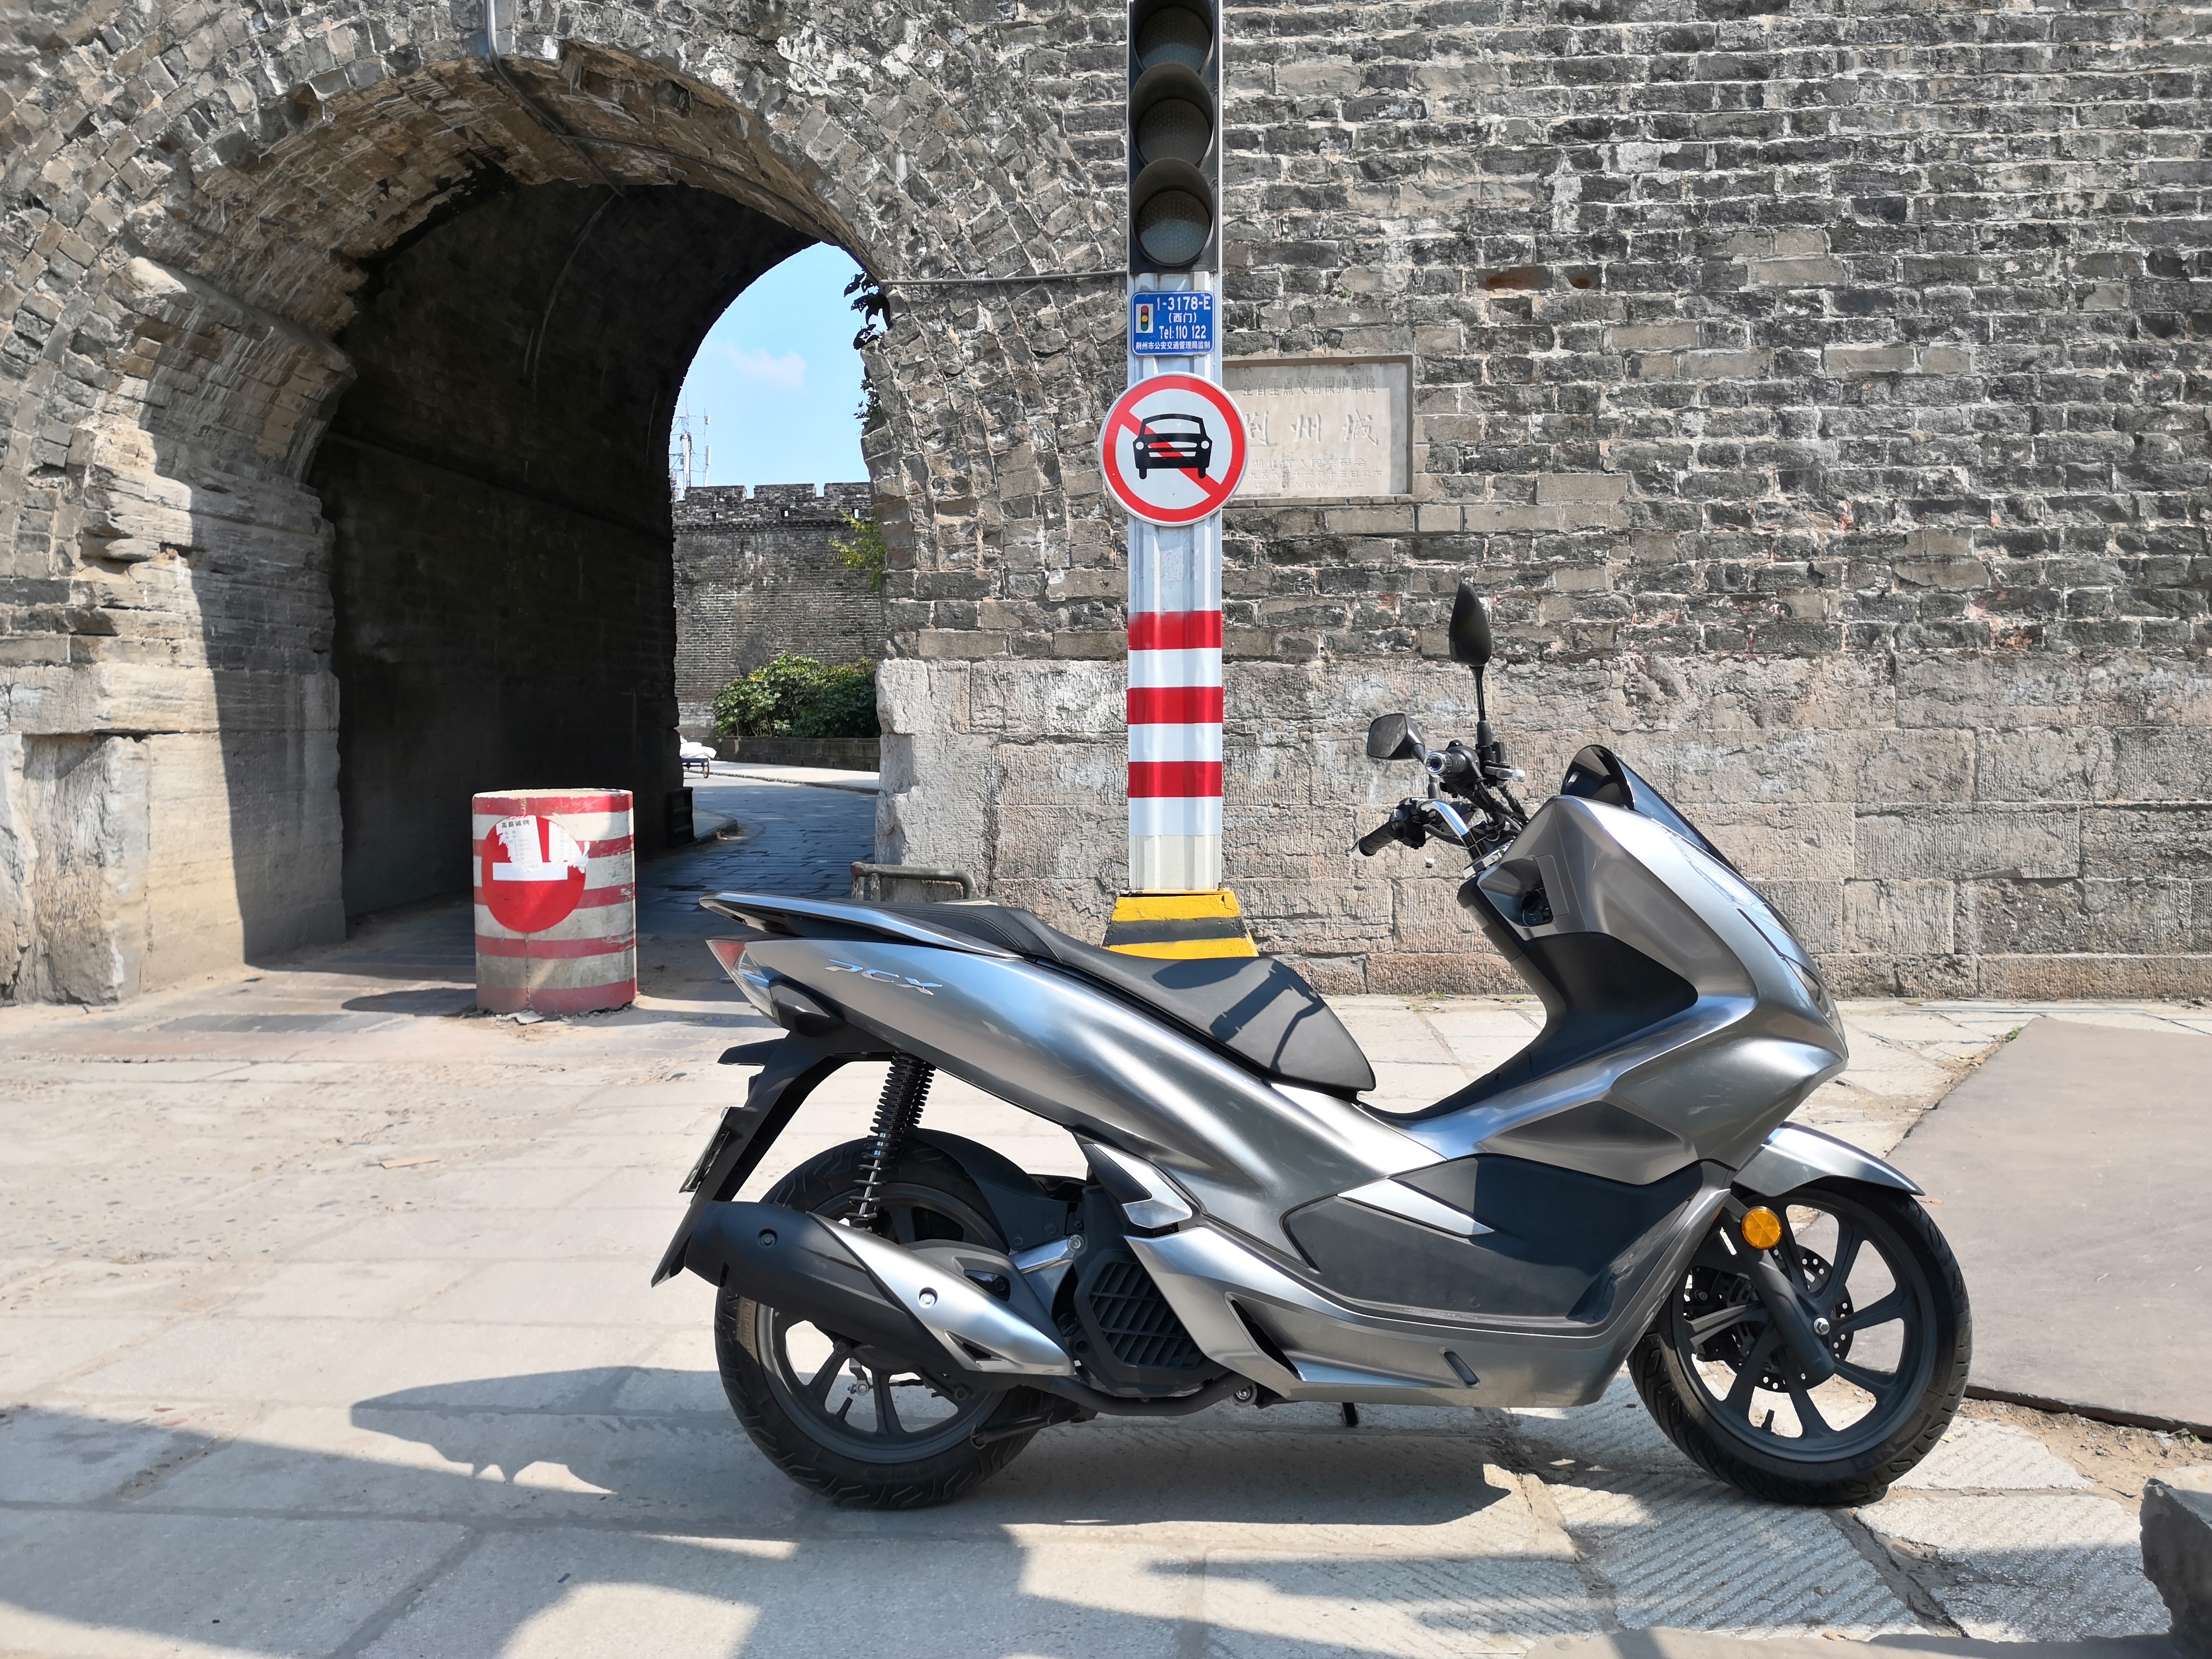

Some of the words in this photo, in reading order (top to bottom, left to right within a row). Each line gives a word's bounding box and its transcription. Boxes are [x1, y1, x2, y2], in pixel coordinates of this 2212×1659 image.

[1157, 296, 1211, 311] 1-3178-E
[1169, 312, 1197, 323] (西门)
[1159, 325, 1188, 340] Tel:110
[1192, 324, 1207, 339] 122
[1135, 341, 1210, 350] 荆州市公安交通管理局监制
[823, 958, 943, 996] PCX
